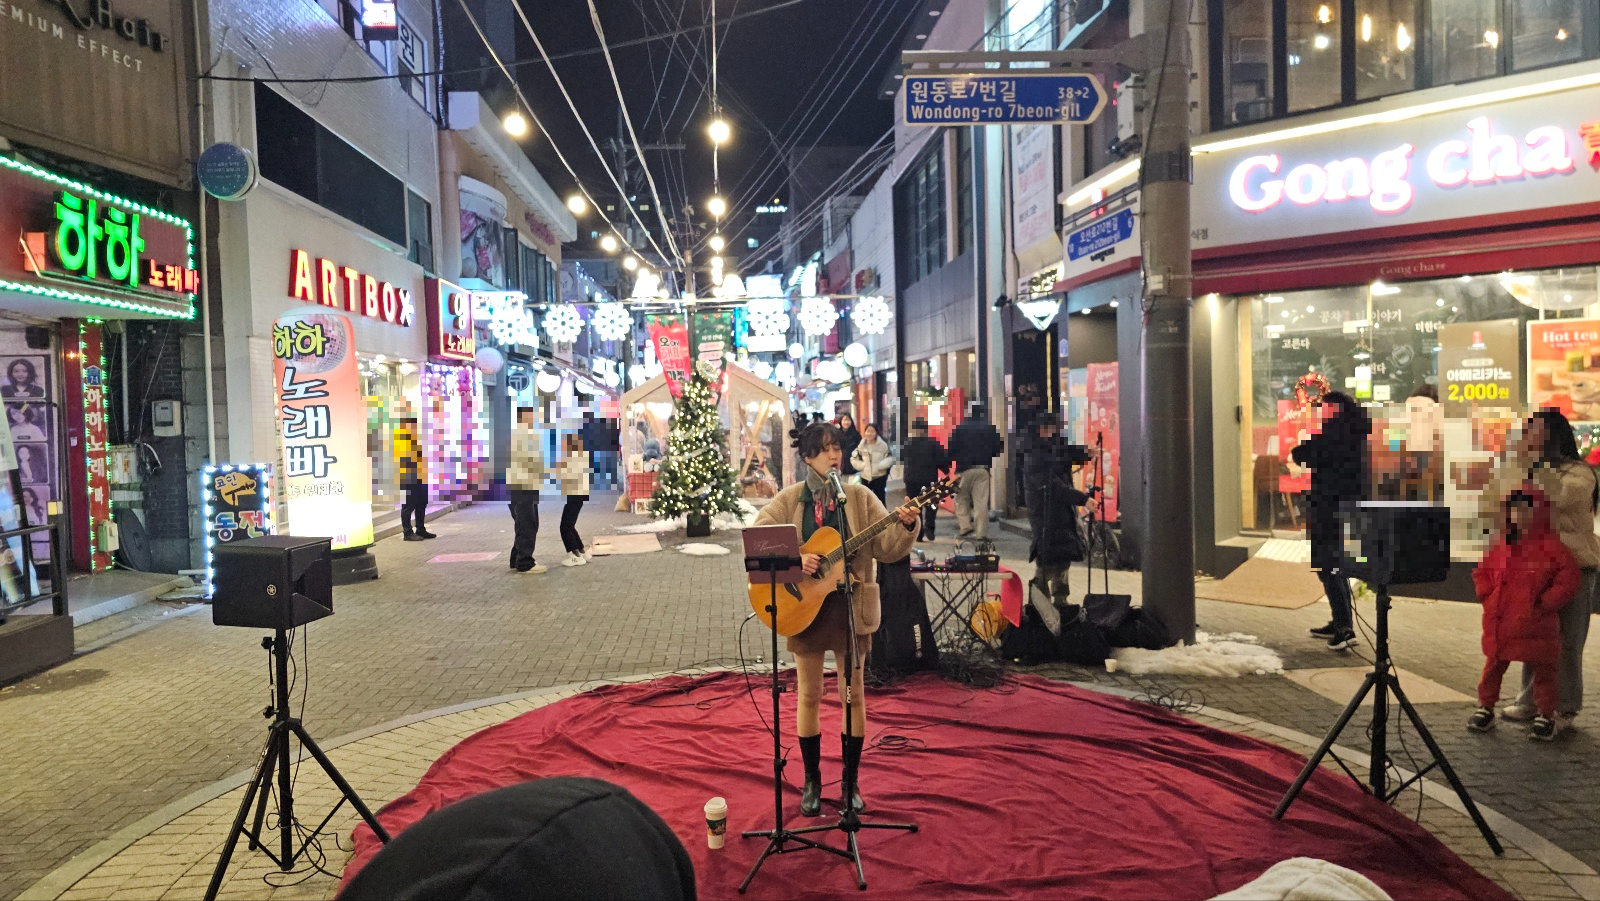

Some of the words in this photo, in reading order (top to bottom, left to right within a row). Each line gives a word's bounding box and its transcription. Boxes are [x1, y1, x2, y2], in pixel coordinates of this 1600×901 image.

[77, 34, 142, 72] EFFECT
[911, 81, 1016, 103] 원동로7번길
[911, 104, 1003, 121] Wondong-ro
[1008, 103, 1081, 121] 7beon-gil
[1228, 143, 1416, 215] Gong
[1426, 116, 1574, 188] cha
[55, 191, 145, 287] 하하
[1380, 266, 1412, 275] Gong
[1413, 262, 1435, 272] cha
[289, 249, 414, 327] ARTBOX
[273, 320, 330, 359] 하하
[1542, 331, 1570, 342] Hot
[1573, 330, 1598, 342] tea
[1446, 367, 1512, 381] 아메리카노
[281, 366, 338, 478] 노래빠
[213, 510, 264, 541] 동전
